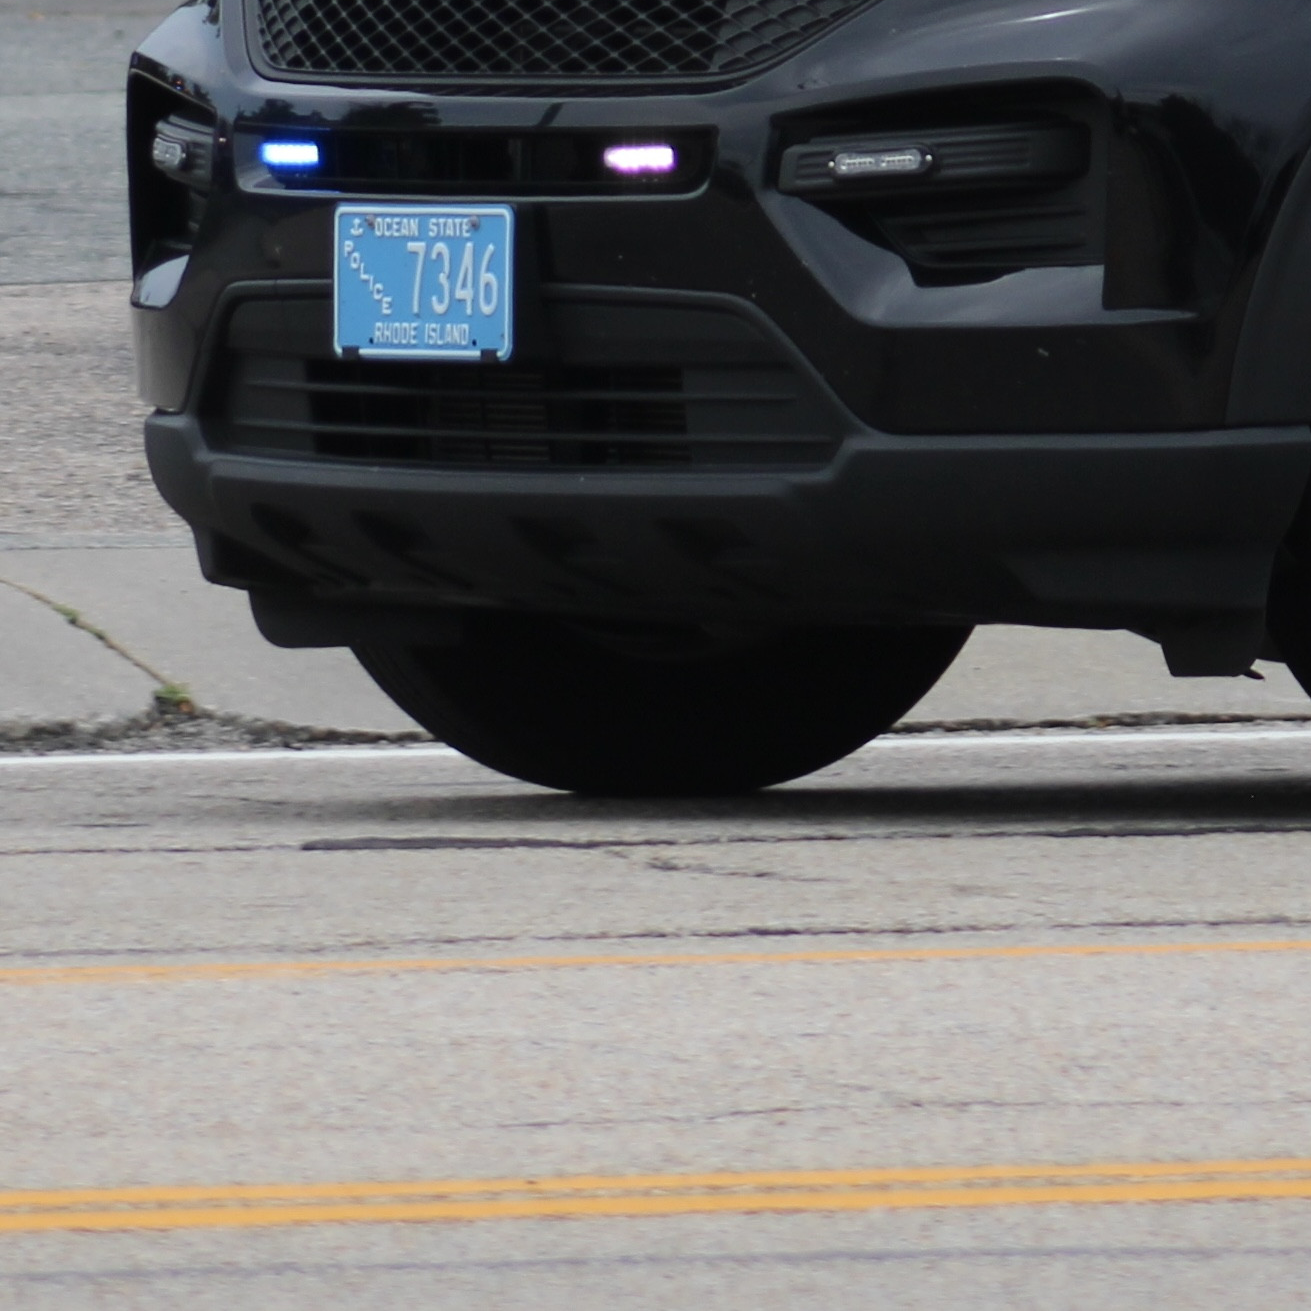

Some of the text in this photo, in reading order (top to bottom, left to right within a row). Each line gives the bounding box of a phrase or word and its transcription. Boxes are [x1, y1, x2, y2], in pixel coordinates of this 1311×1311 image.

[374, 217, 472, 238] OCEAN STATE
[343, 240, 392, 315] POLICE
[406, 241, 499, 317] 7346
[373, 322, 470, 346] RHODE ISLAND
